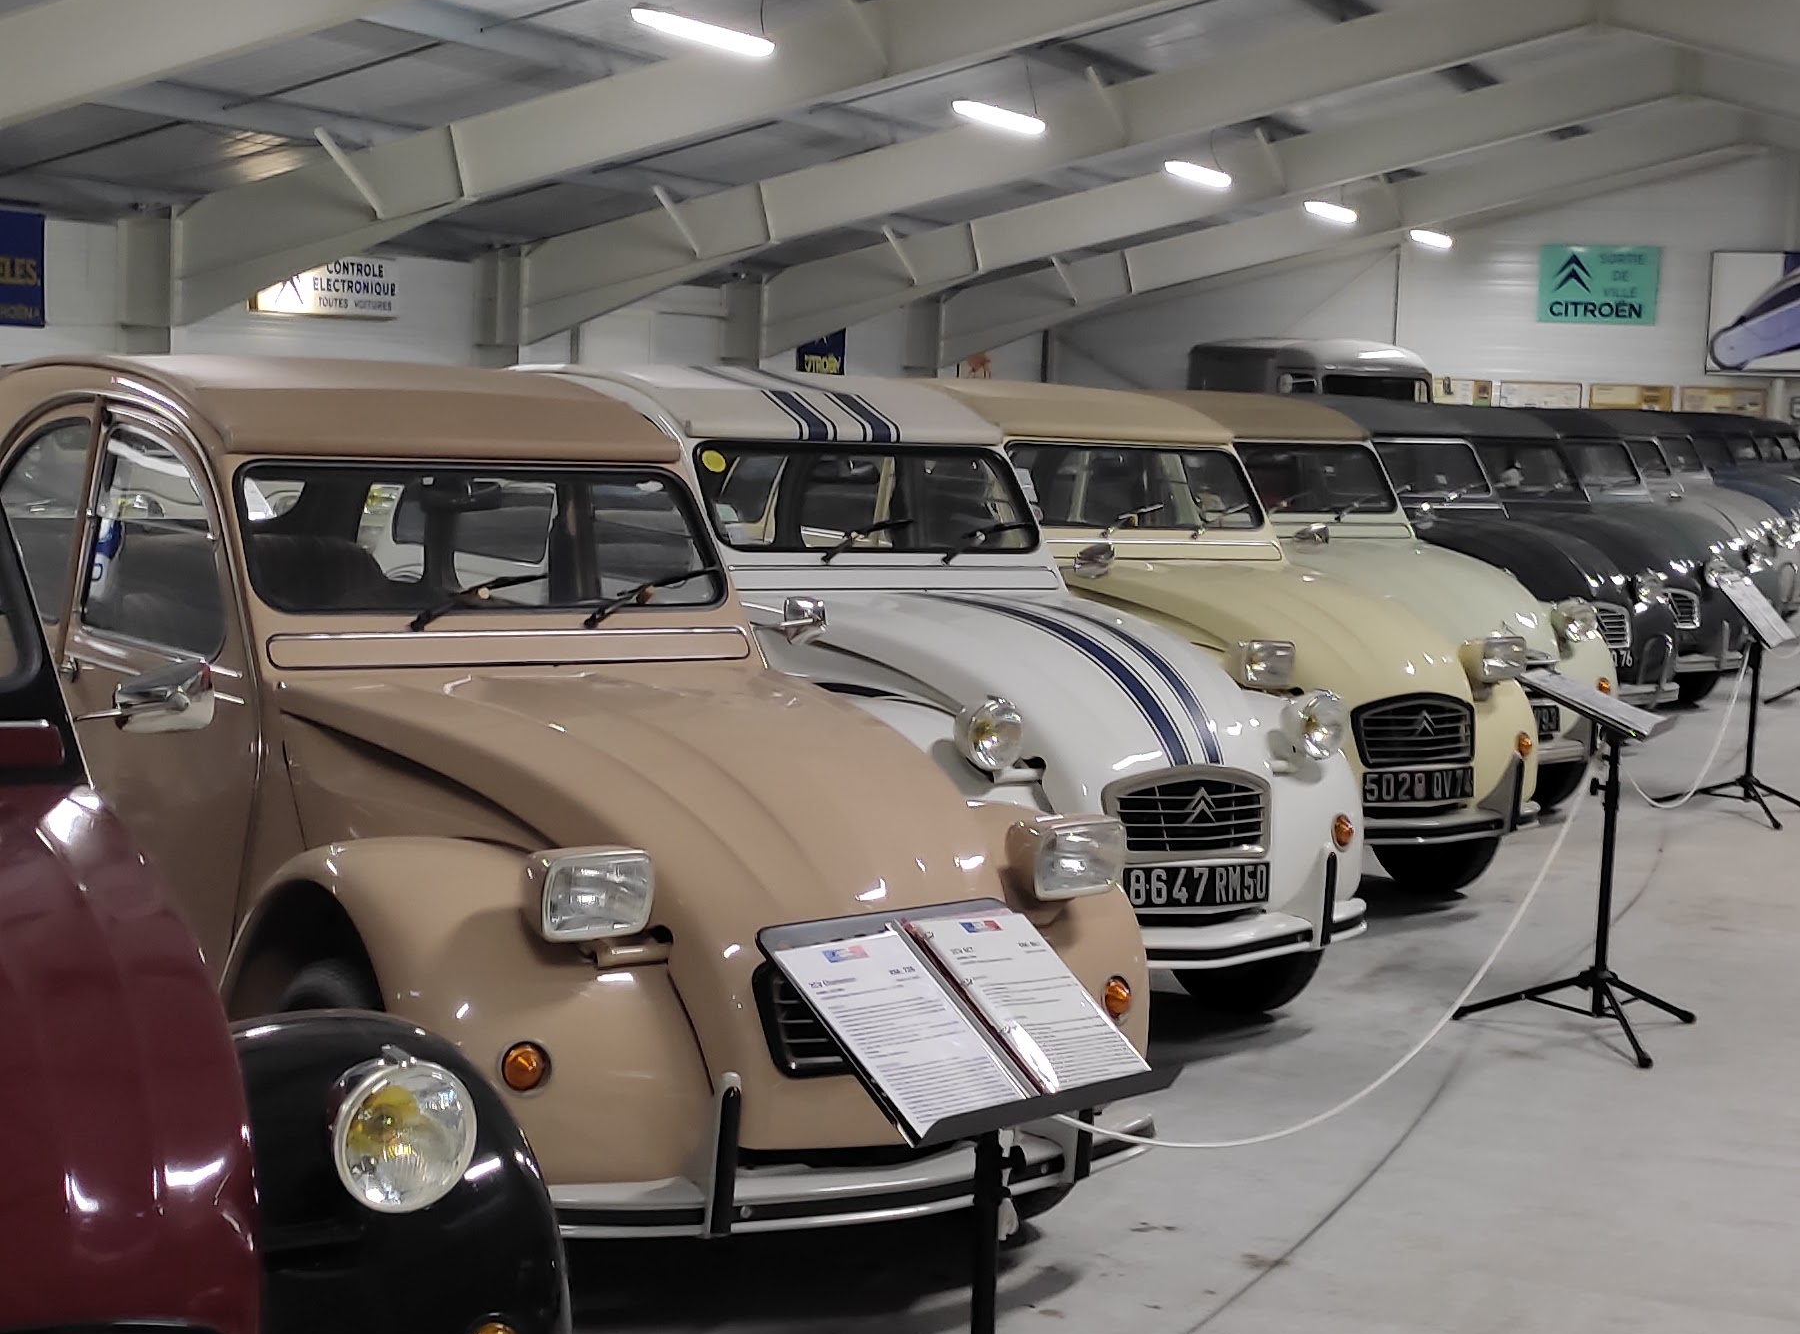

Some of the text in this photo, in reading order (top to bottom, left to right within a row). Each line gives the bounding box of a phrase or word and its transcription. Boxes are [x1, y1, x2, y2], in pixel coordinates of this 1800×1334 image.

[318, 296, 349, 309] TOUTES
[1549, 299, 1643, 319] CITROËN
[1620, 649, 1633, 668] 76
[1364, 772, 1427, 801] 5028
[1129, 867, 1209, 906] 8647
